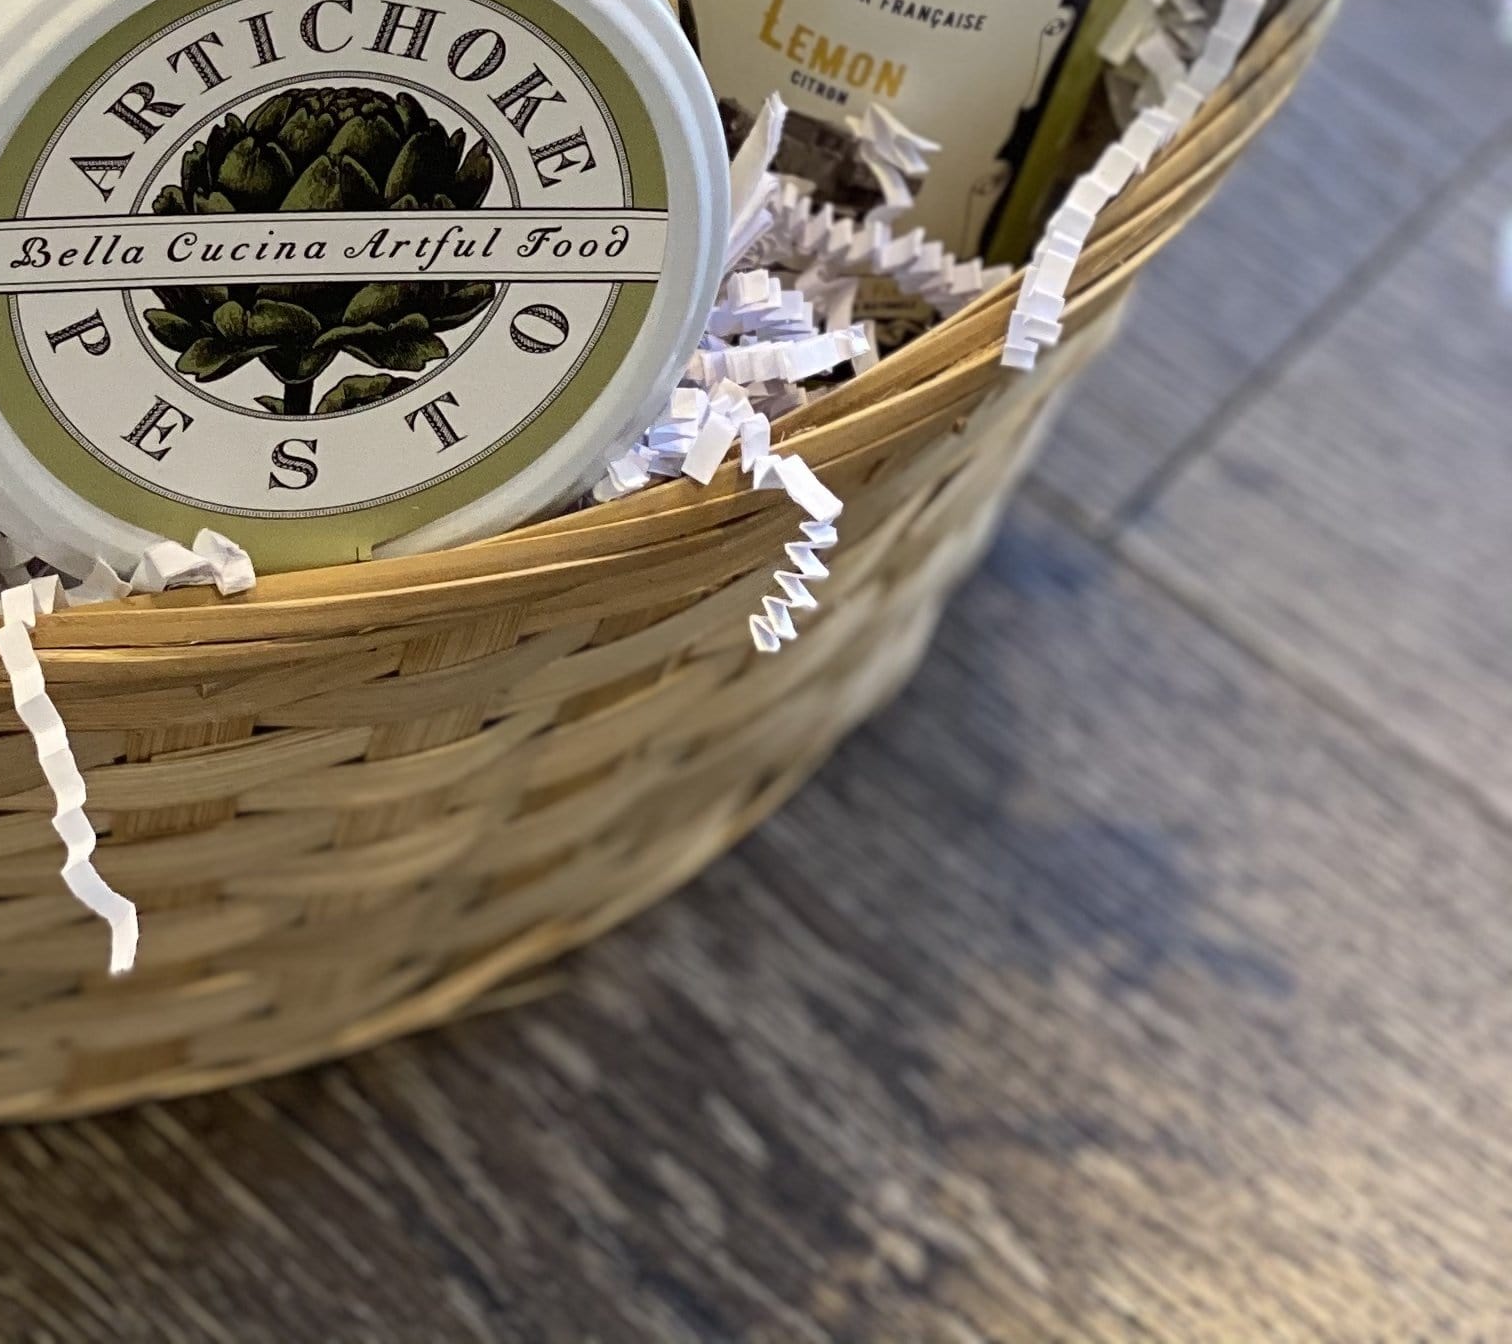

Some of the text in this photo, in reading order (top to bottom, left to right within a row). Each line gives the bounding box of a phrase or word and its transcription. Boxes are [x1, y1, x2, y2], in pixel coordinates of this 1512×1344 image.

[790, 69, 849, 107] CITRON
[10, 224, 631, 273] Bella Cucina Artful Food
[45, 302, 571, 492] PESTO
